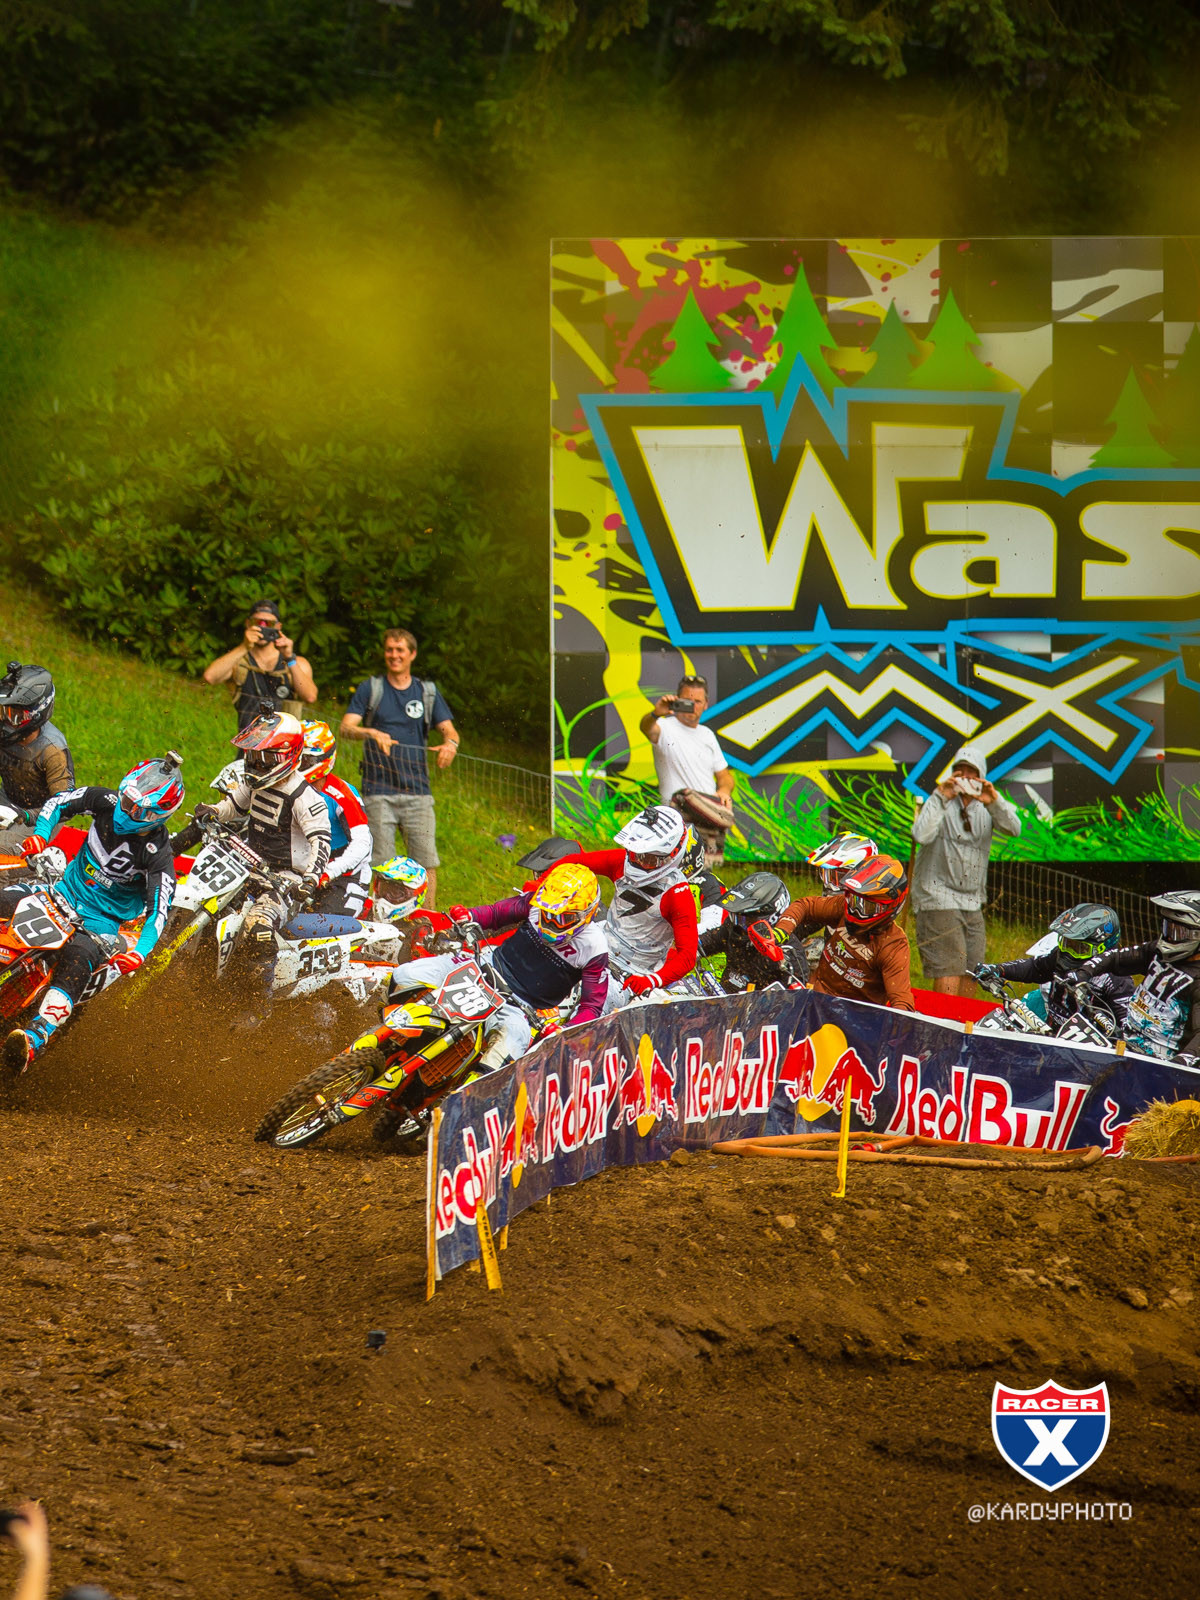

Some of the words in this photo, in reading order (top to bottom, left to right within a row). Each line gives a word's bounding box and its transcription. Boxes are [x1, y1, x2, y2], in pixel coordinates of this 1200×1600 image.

[717, 655, 1140, 787] MX
[191, 854, 237, 893] 333
[12, 903, 63, 947] 19
[299, 946, 342, 978] 333
[444, 975, 491, 1017] 738
